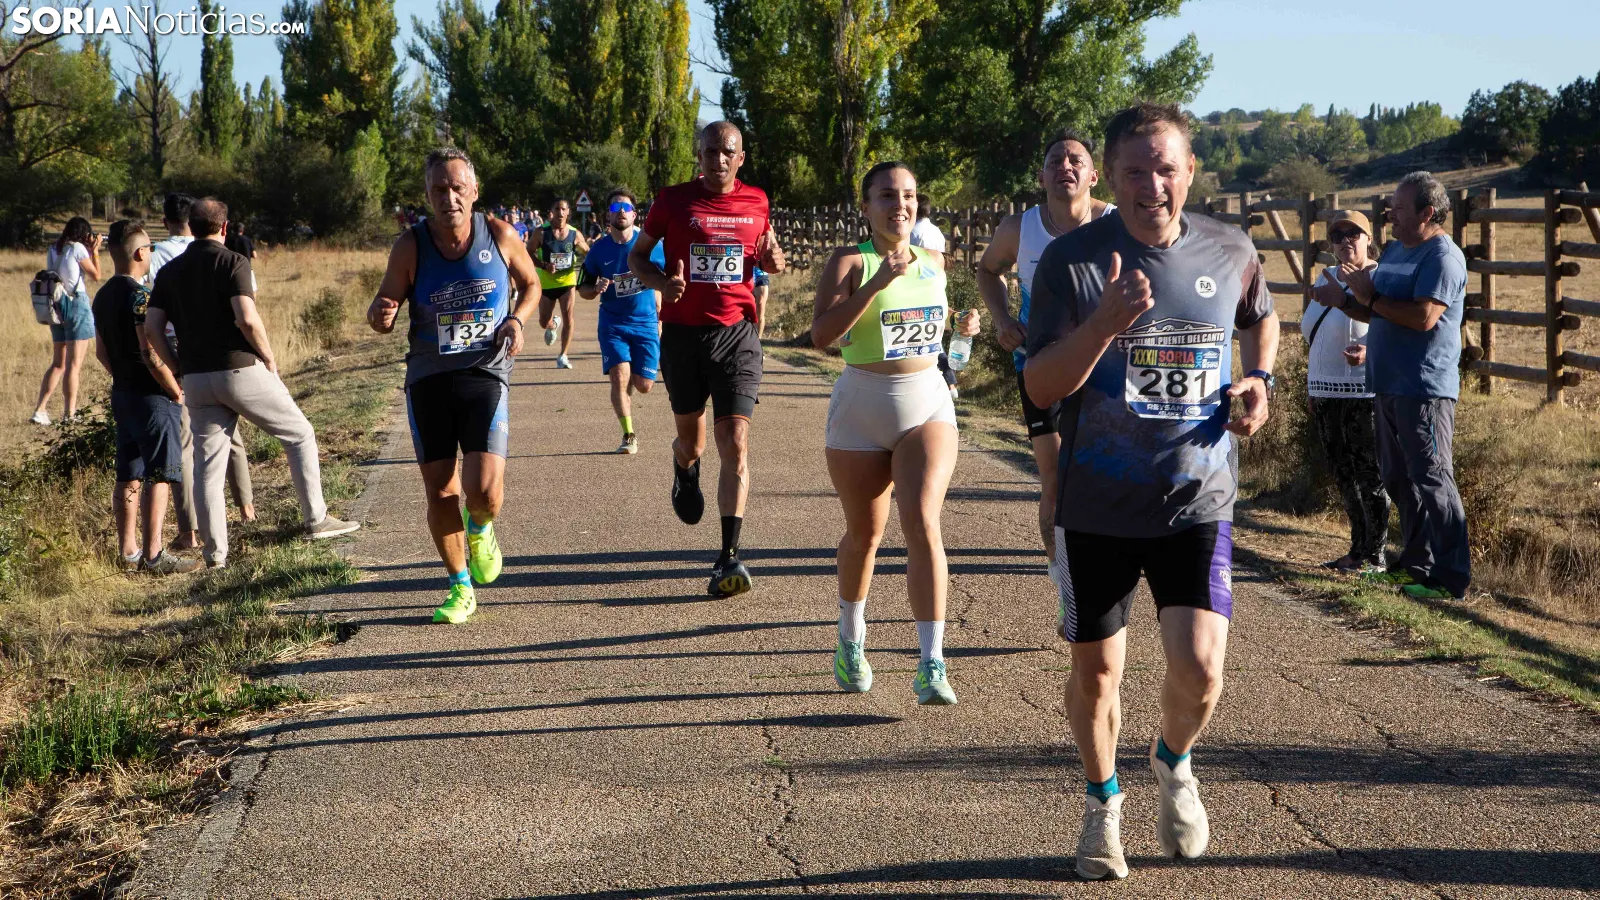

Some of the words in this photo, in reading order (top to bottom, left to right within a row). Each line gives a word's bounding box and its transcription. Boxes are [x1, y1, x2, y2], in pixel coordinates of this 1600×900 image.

[696, 256, 736, 272] 376
[443, 295, 487, 310] SORIA
[453, 312, 474, 321] SORIA
[901, 310, 925, 321] SORIA
[445, 323, 488, 340] 132
[891, 322, 938, 346] 229
[1157, 335, 1185, 345] PUENTE
[1187, 334, 1201, 343] DEL
[1202, 332, 1224, 342] CANTO
[1133, 349, 1158, 366] XXXII
[1158, 350, 1195, 364] SORIA
[1138, 368, 1207, 398] 281
